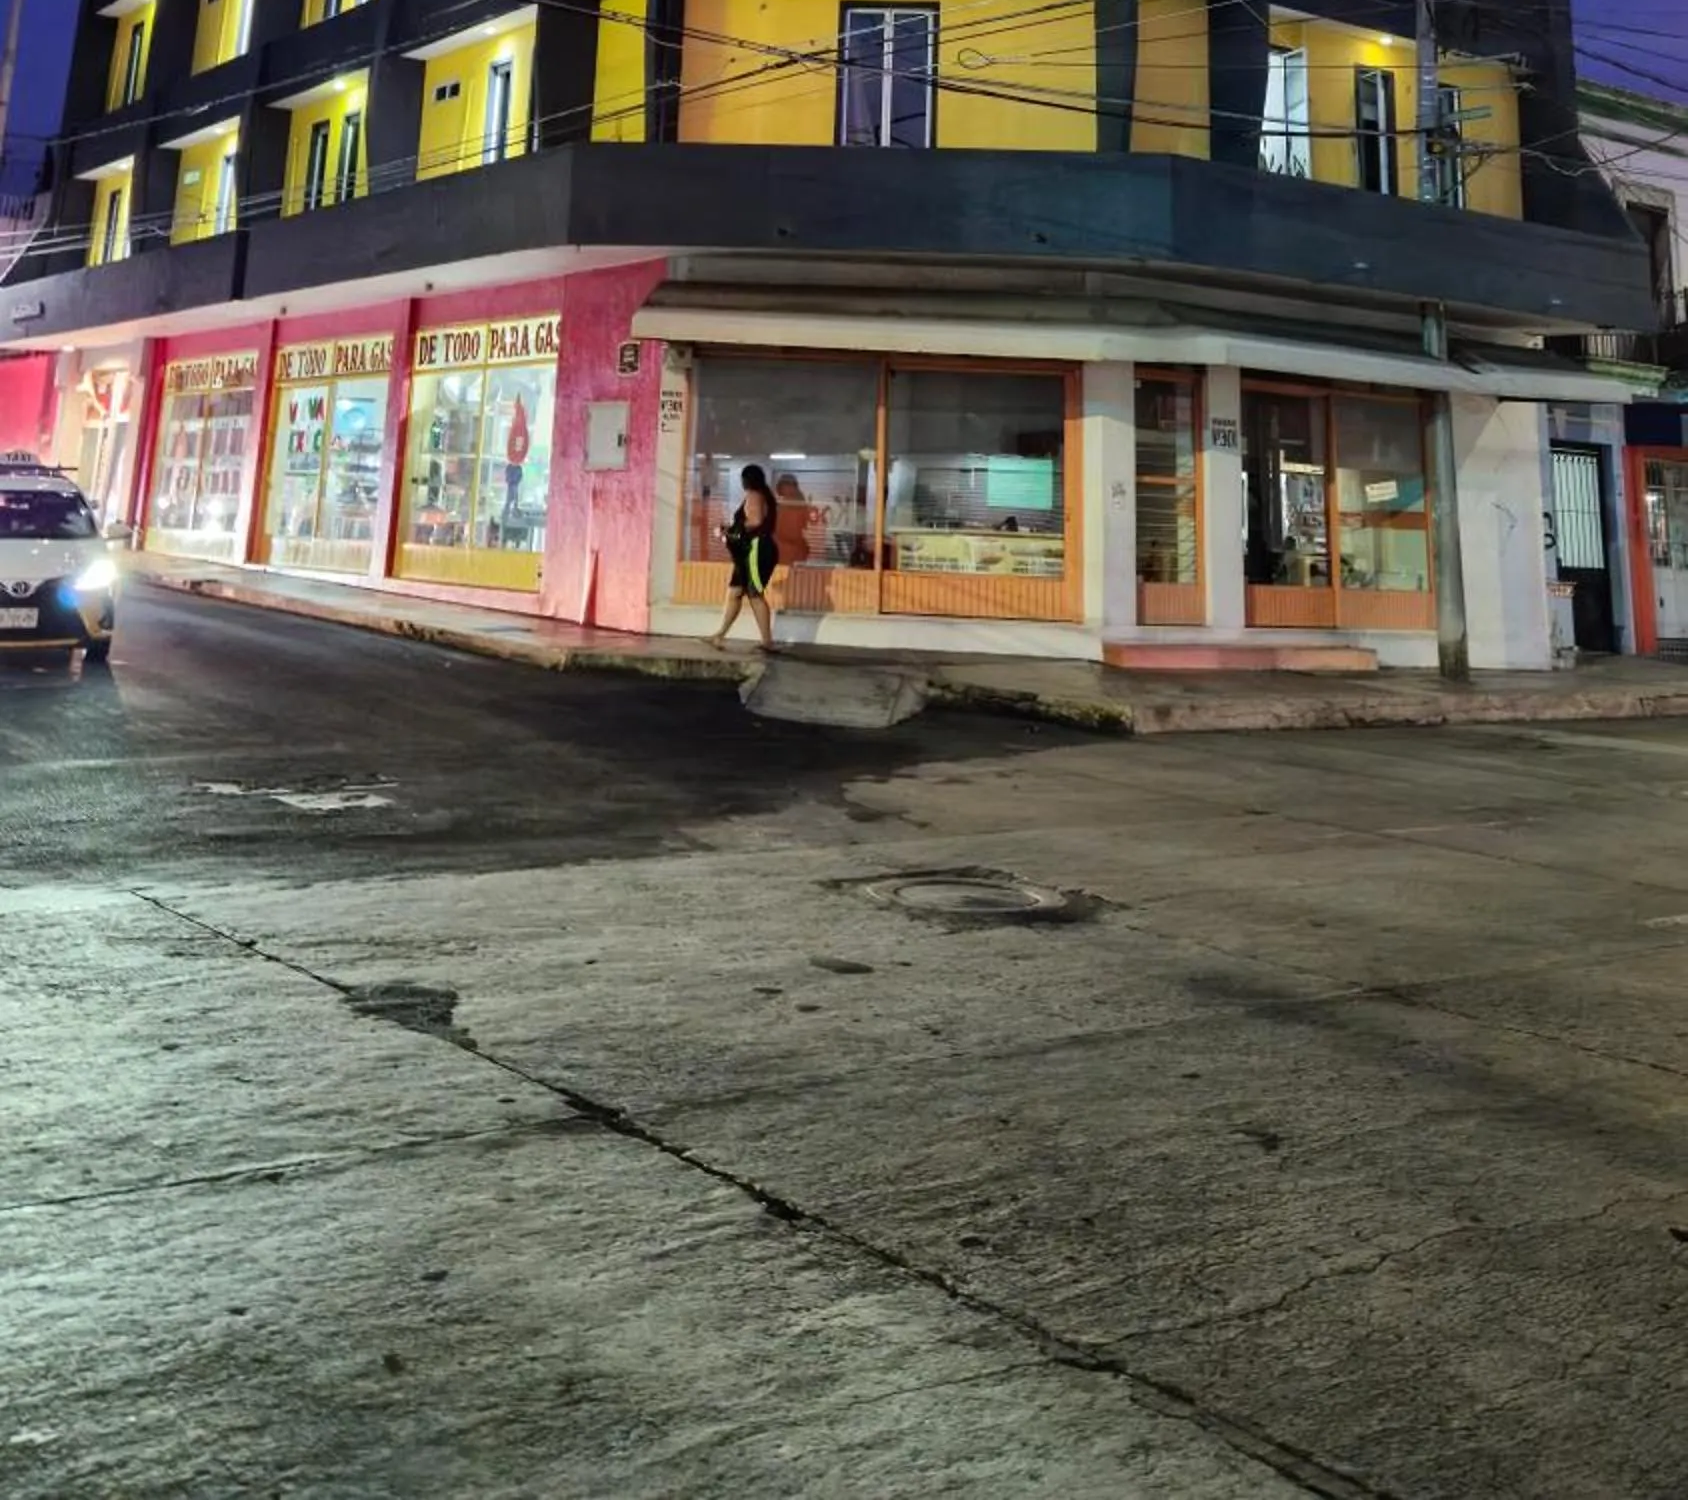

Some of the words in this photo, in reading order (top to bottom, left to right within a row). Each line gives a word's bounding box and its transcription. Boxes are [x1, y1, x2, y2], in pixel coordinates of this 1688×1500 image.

[419, 334, 437, 366] DE
[444, 331, 481, 363] TODO
[489, 324, 530, 359] PARA
[280, 351, 293, 379] DE
[297, 348, 327, 377] TODO
[336, 344, 366, 372] PARA
[289, 396, 325, 425] VVA
[6, 451, 31, 462] TAXI
